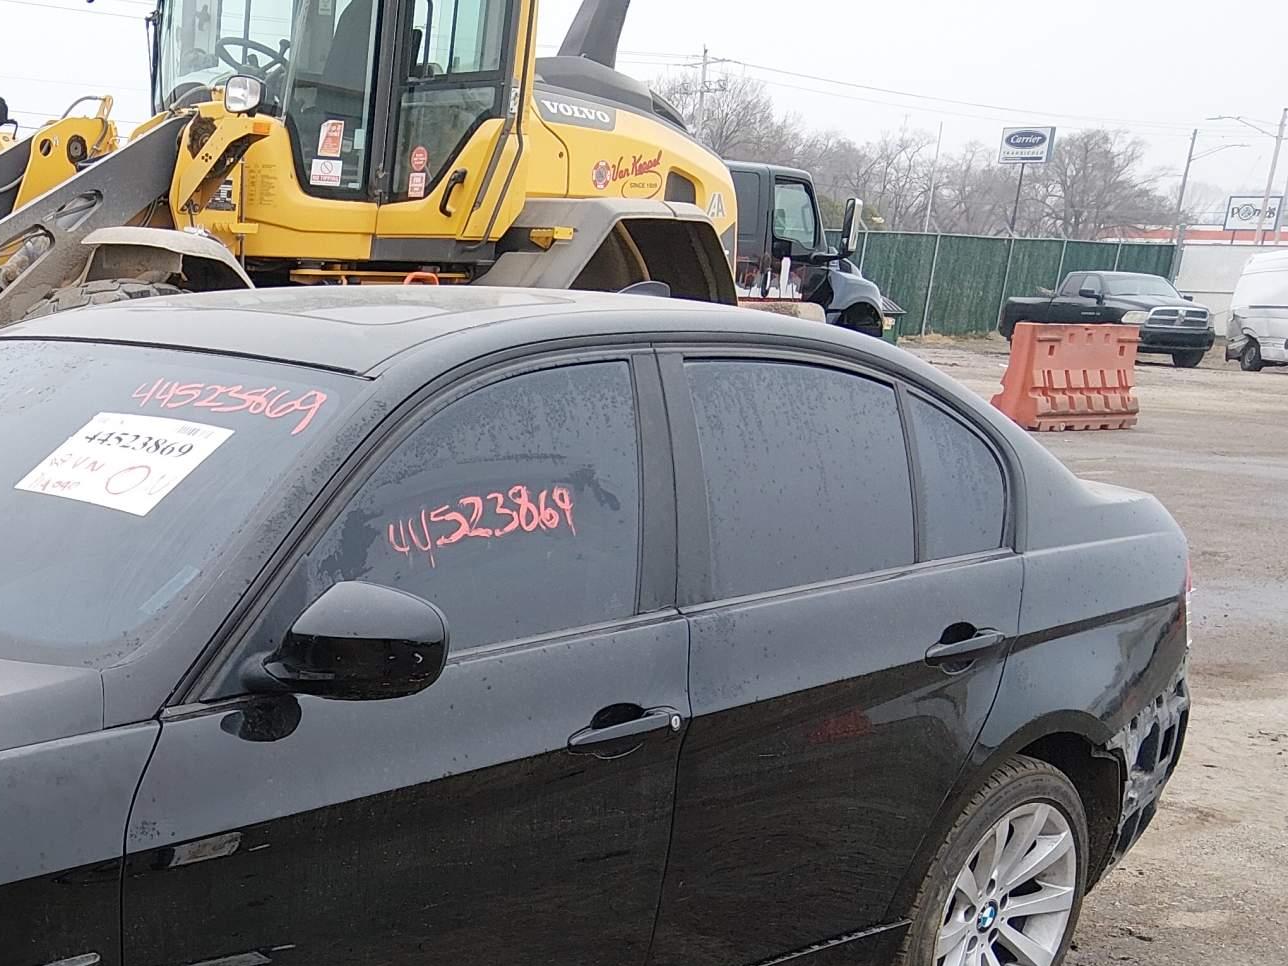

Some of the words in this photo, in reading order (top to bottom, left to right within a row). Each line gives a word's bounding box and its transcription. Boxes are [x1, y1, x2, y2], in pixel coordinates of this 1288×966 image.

[540, 99, 610, 123] VOLVO
[1010, 135, 1043, 144] Carrier
[611, 157, 630, 181] Van
[132, 377, 328, 436] 44523869
[84, 431, 194, 457] 44523869
[389, 484, 577, 568] 44523869
